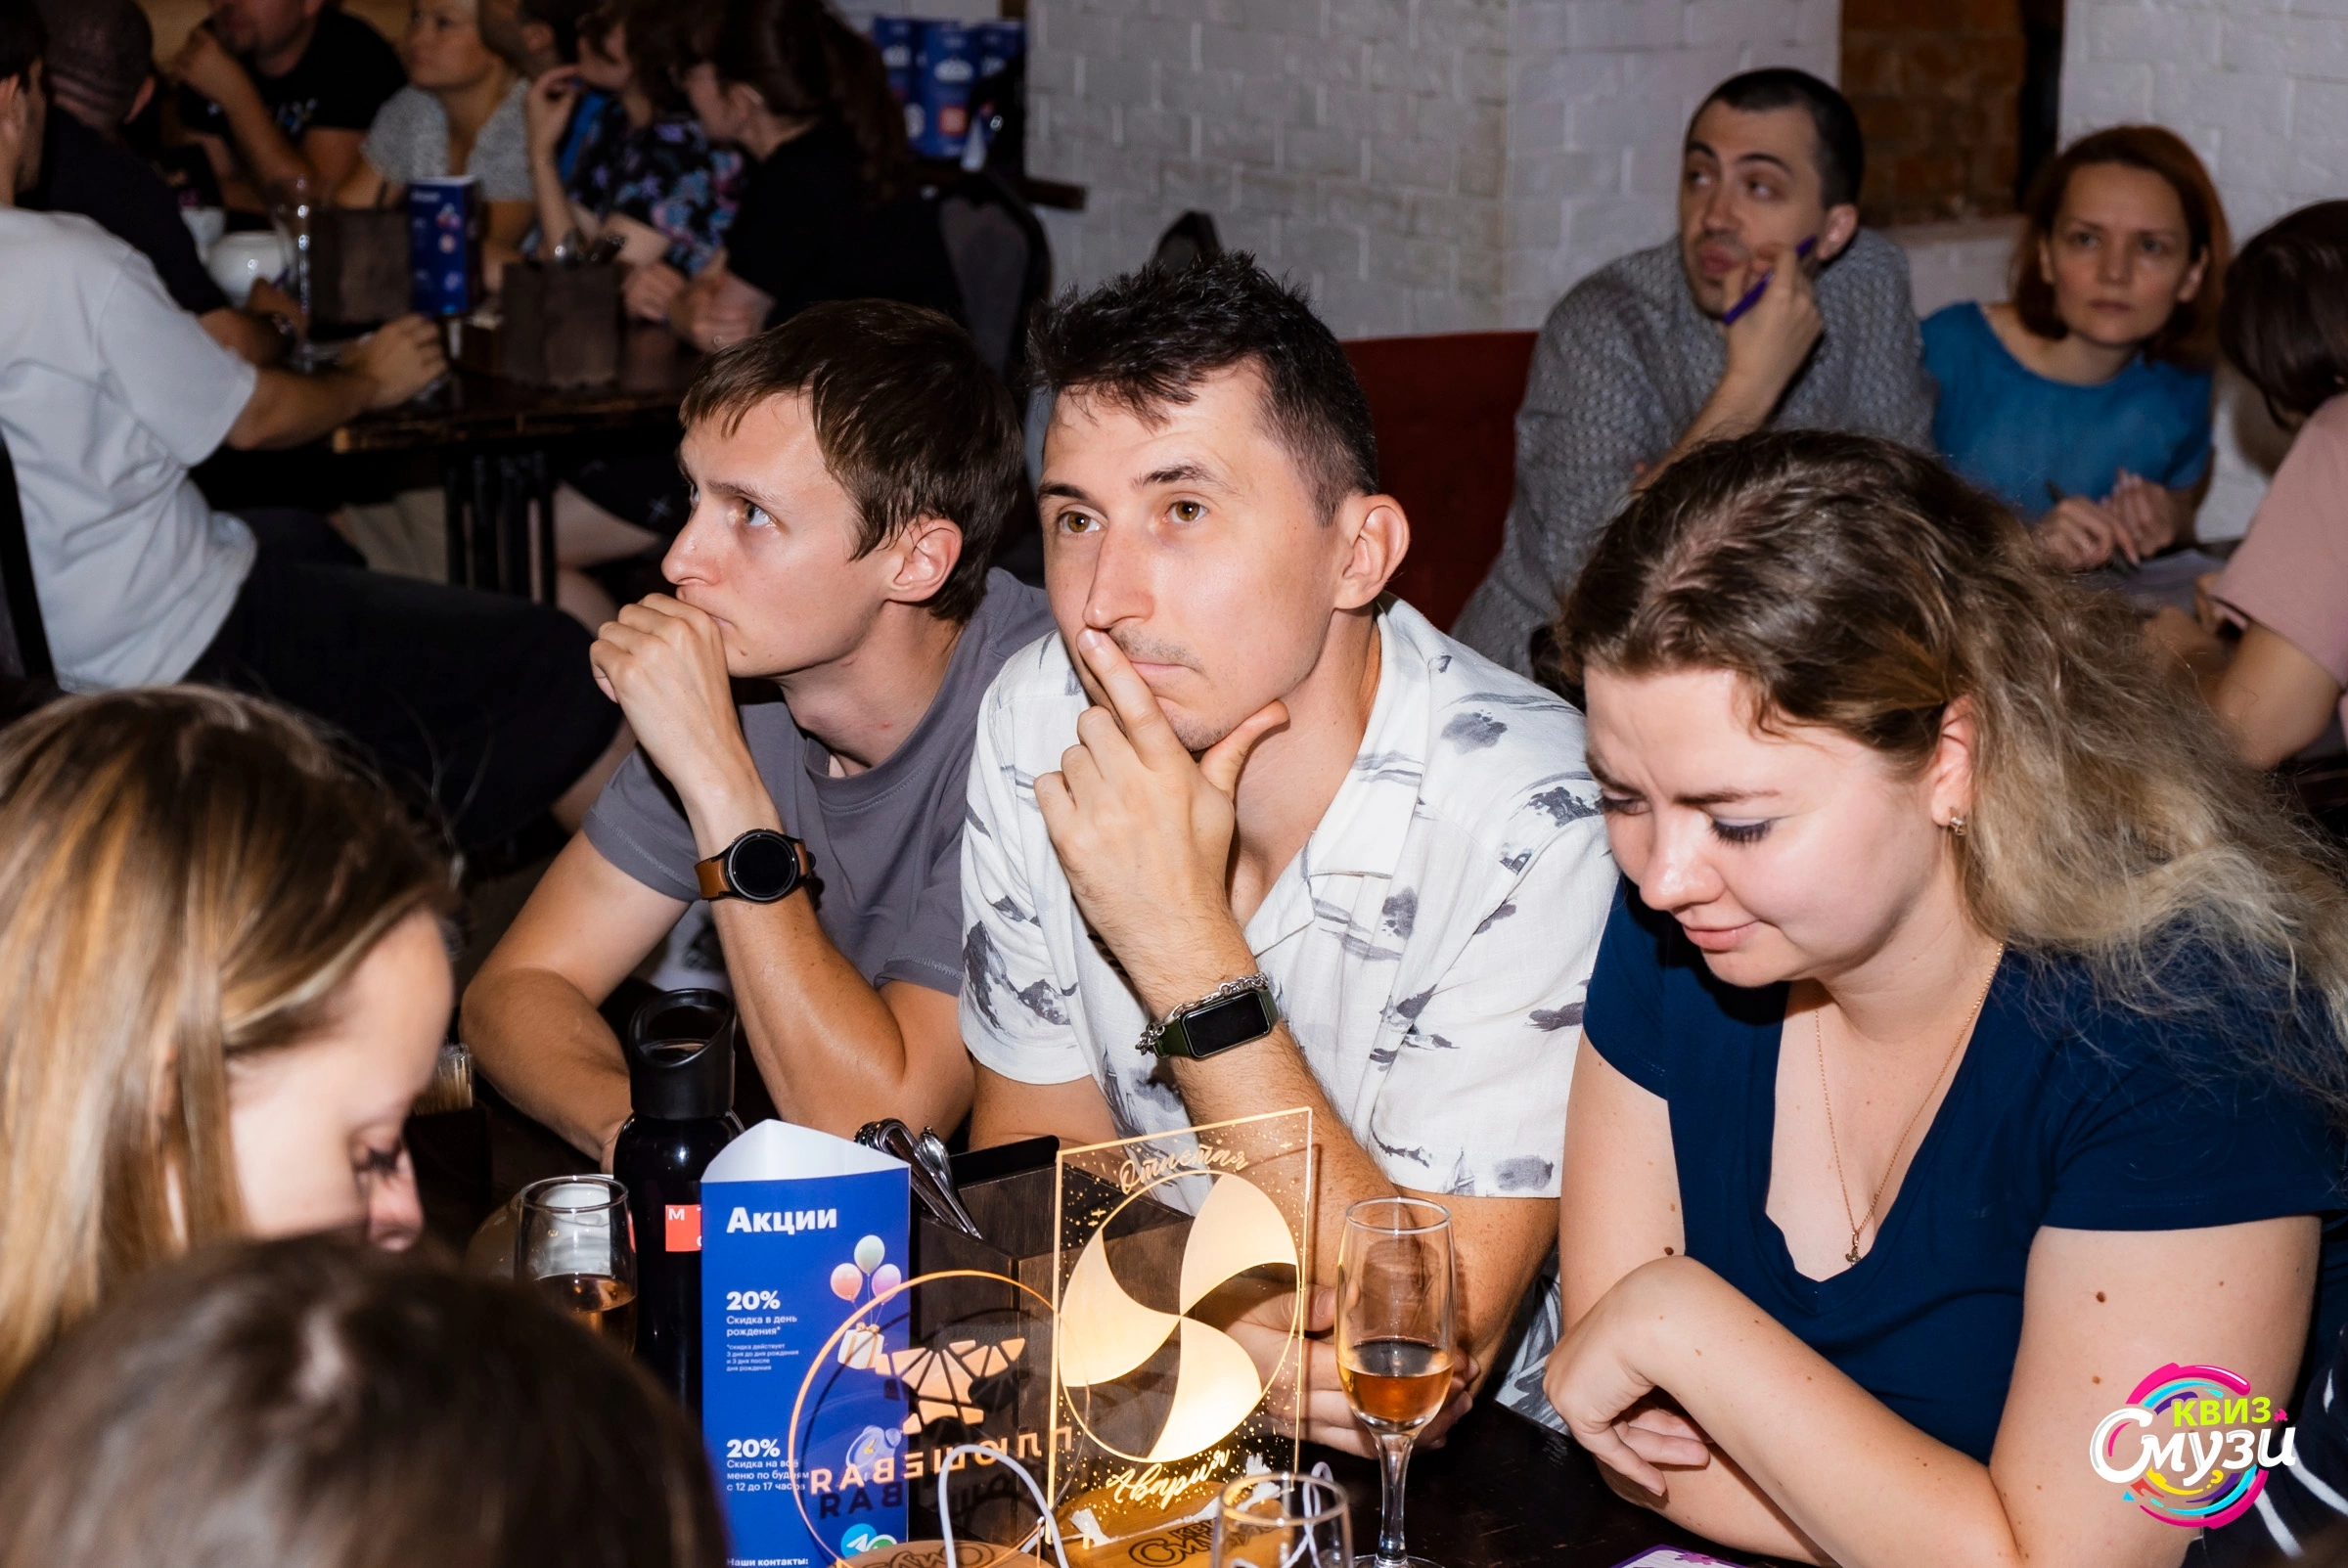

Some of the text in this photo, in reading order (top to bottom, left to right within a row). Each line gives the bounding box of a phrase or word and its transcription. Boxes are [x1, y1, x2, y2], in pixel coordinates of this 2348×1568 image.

[1119, 1143, 1249, 1194] Отпетая
[726, 1207, 837, 1235] Акции
[726, 1290, 781, 1311] 20%
[726, 1316, 763, 1324] Скидка
[773, 1316, 797, 1324] день
[726, 1438, 781, 1458] 20%
[726, 1459, 763, 1469] Скидка
[736, 1482, 745, 1491] 12
[747, 1483, 761, 1492] до
[763, 1482, 773, 1491] 17
[1106, 1449, 1231, 1509] Авария
[757, 1557, 809, 1566] контакты:
